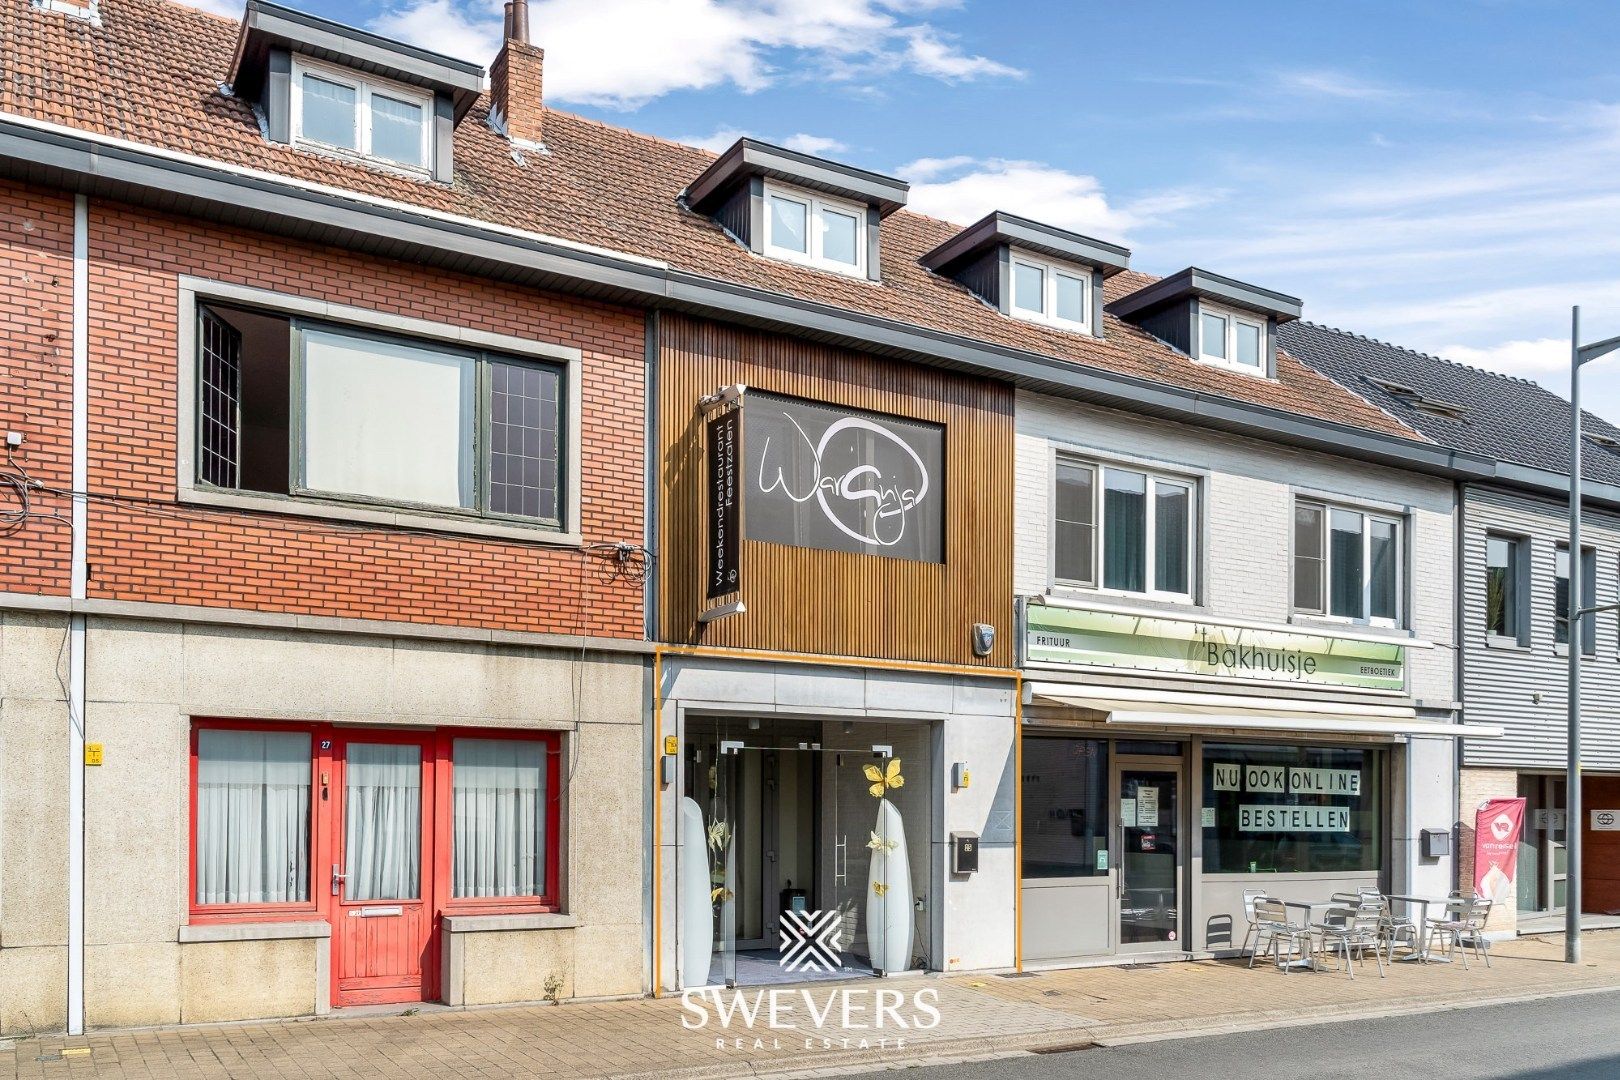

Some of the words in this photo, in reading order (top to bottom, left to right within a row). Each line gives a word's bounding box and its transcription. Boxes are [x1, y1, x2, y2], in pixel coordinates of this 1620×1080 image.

[725, 419, 733, 506] Feestzalen
[716, 425, 724, 586] Weekendrestaurant
[1036, 636, 1070, 647] FRITUUR
[1207, 642, 1316, 679] Bakhuisje
[1360, 666, 1395, 676] EETBOETIEK
[321, 741, 330, 749] 27
[1216, 768, 1238, 787] NU
[1249, 770, 1283, 788] OOK
[1291, 772, 1358, 792] ONLINE
[1241, 810, 1348, 828] BESTELLEN
